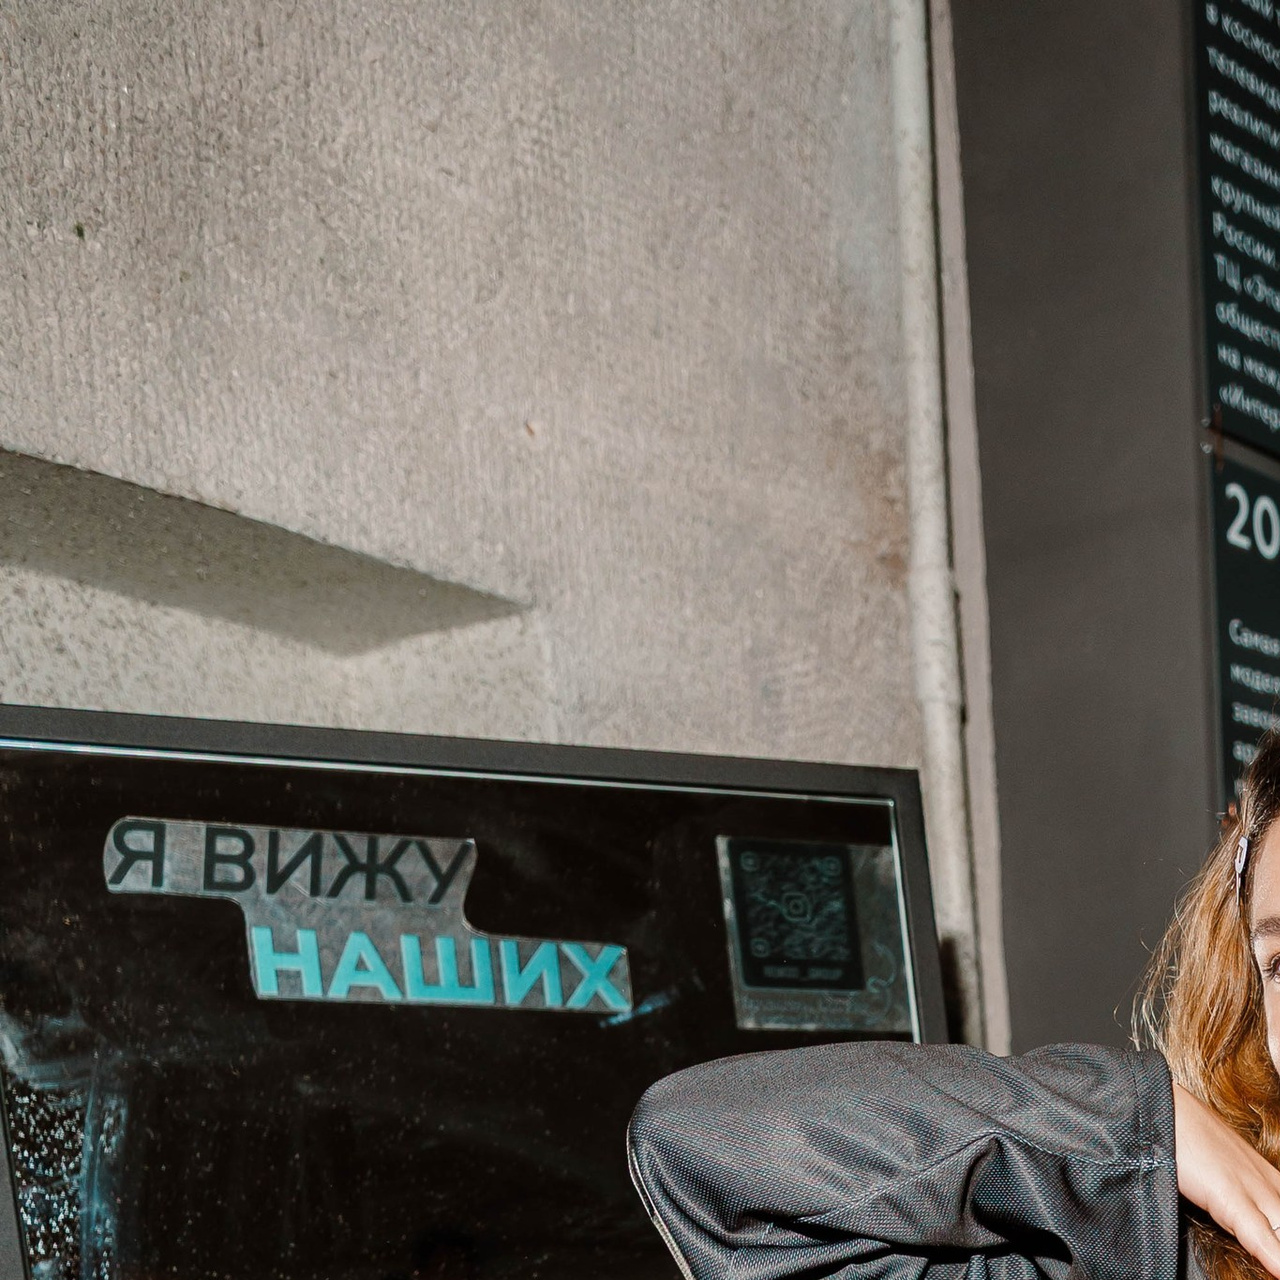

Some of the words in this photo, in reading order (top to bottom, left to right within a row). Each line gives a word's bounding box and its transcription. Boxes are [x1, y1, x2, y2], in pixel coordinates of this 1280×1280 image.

[111, 820, 166, 890] Я
[203, 827, 475, 906] ВИЖУ
[251, 925, 631, 1012] НАШИХ
